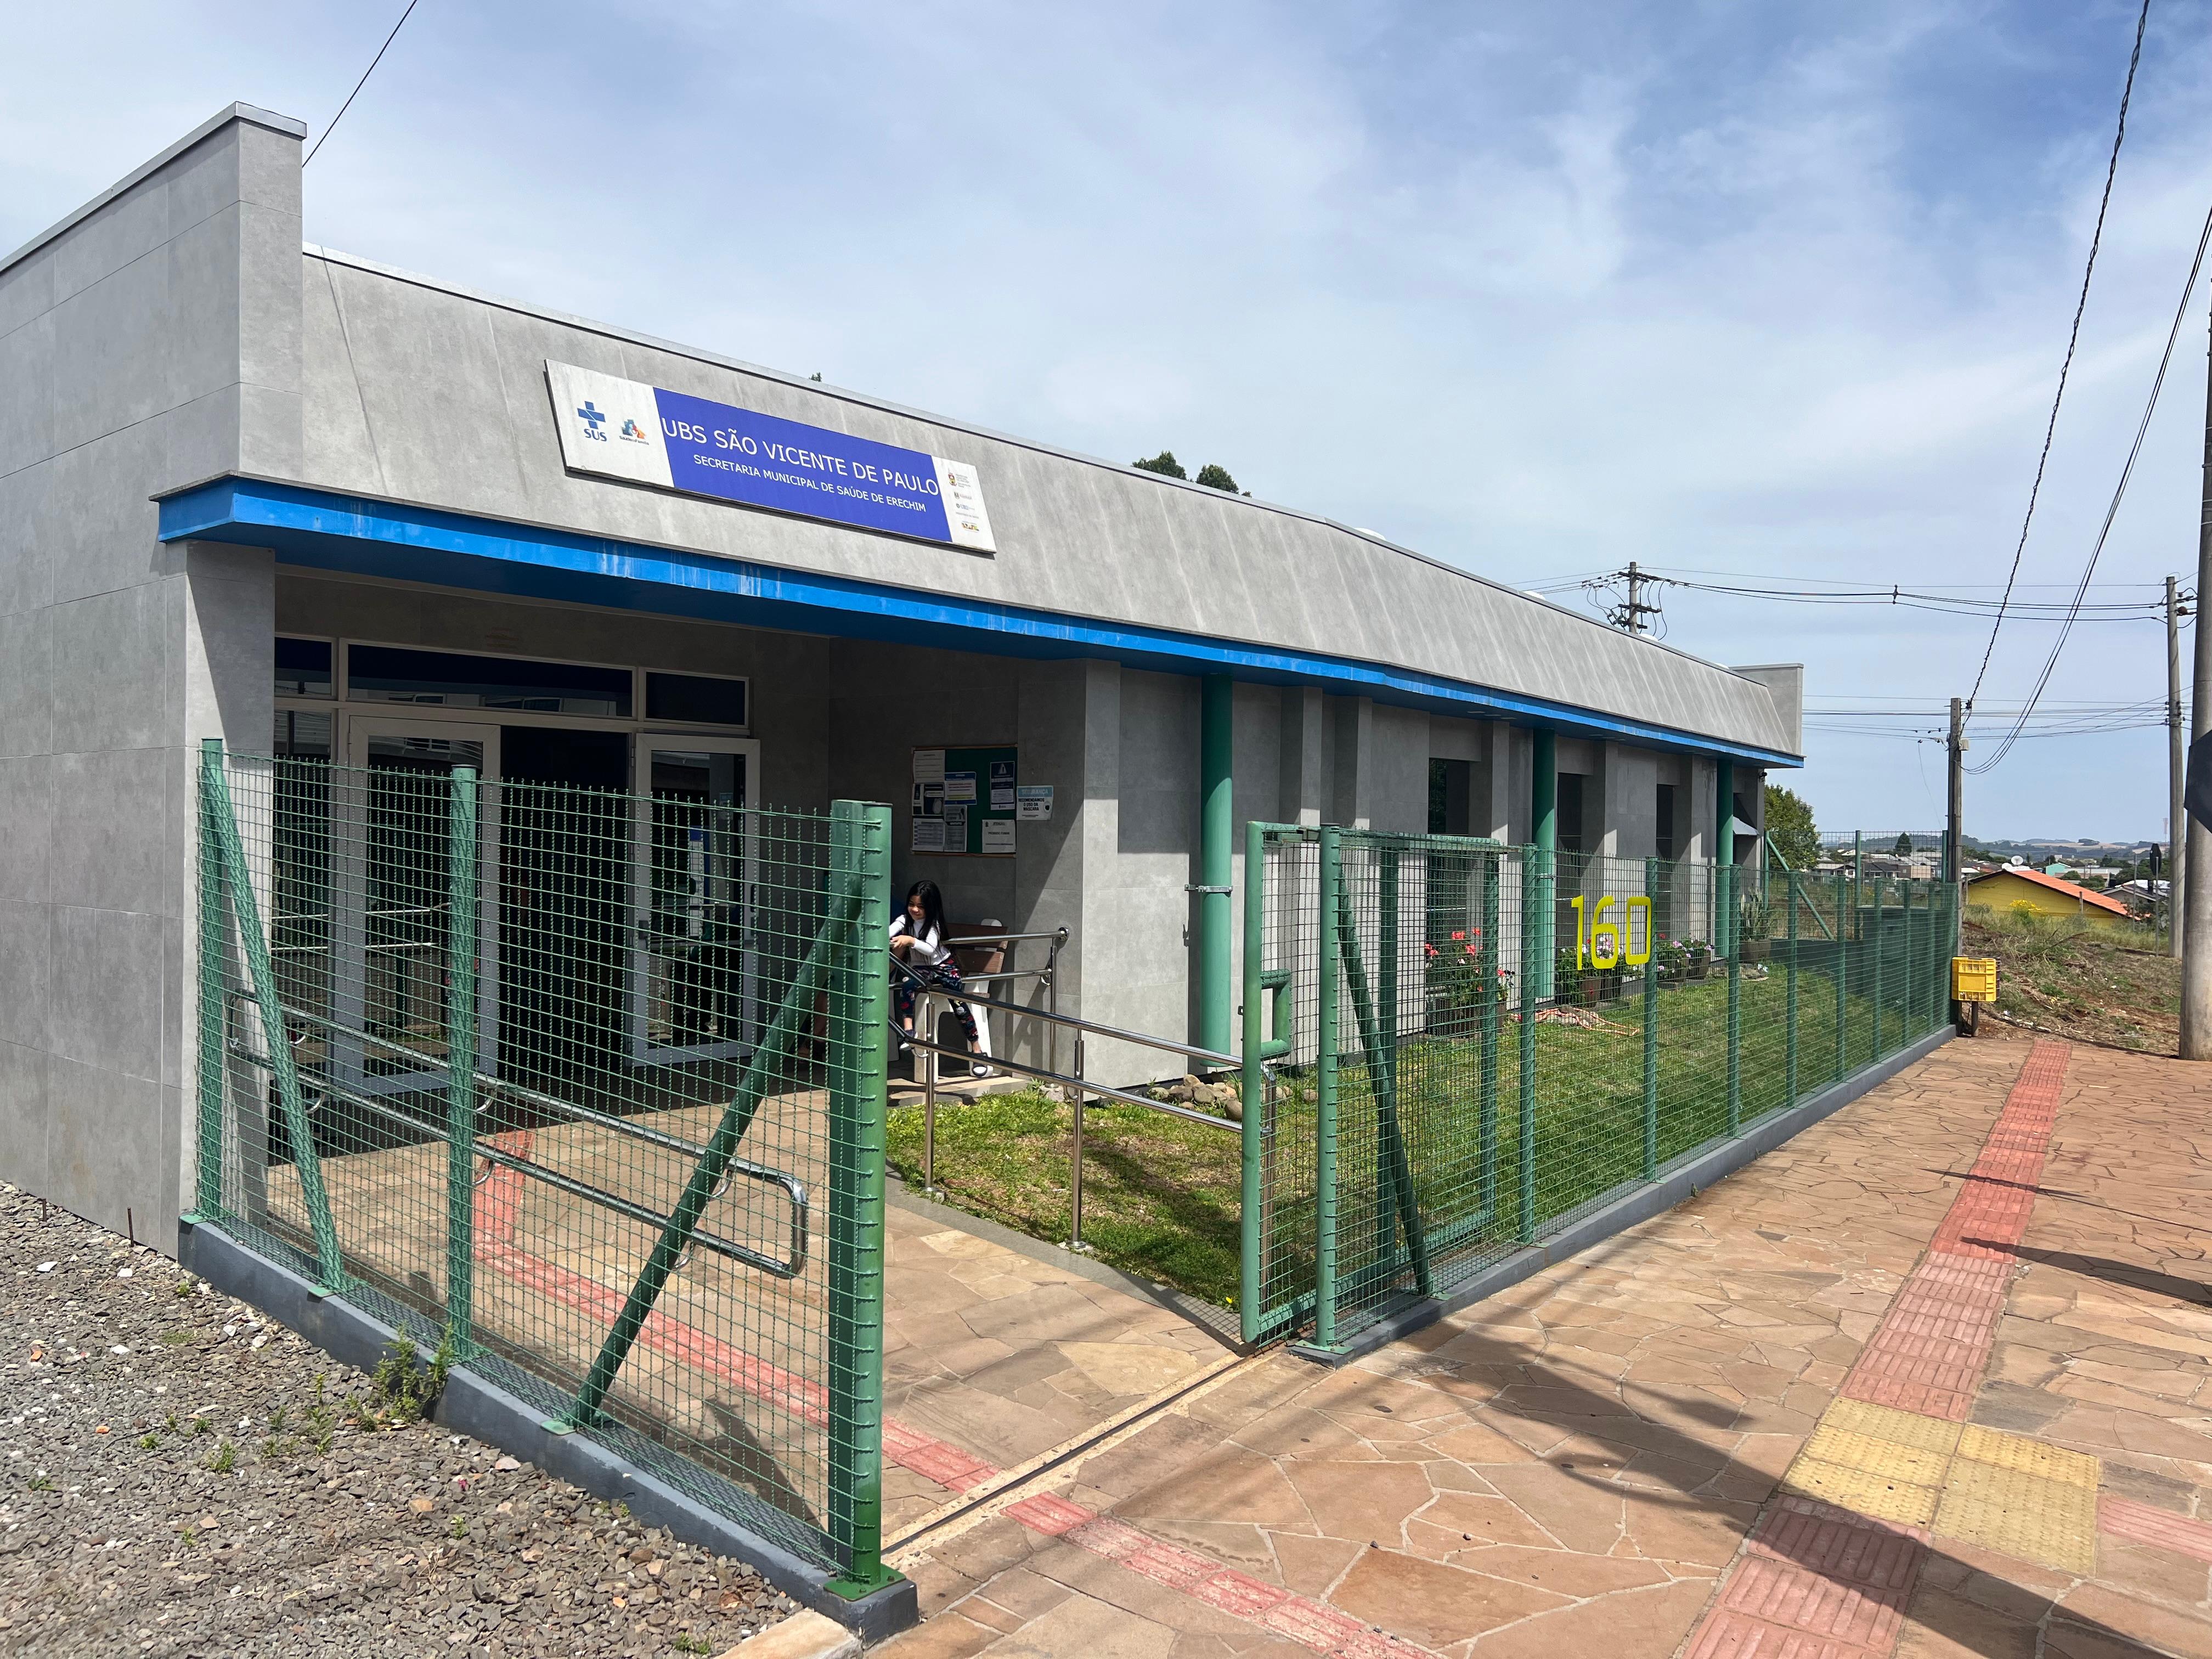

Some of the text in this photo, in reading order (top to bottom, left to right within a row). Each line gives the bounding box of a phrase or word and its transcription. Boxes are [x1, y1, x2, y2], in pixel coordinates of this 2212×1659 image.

[584, 428, 607, 442] SUS
[661, 417, 939, 496] UBS SÃO VICENTE DE PAULO
[693, 454, 926, 512] SECRETARIA MUNICIPAL DE SAÚDE DE ERECHIM
[1571, 895, 1652, 970] 160
